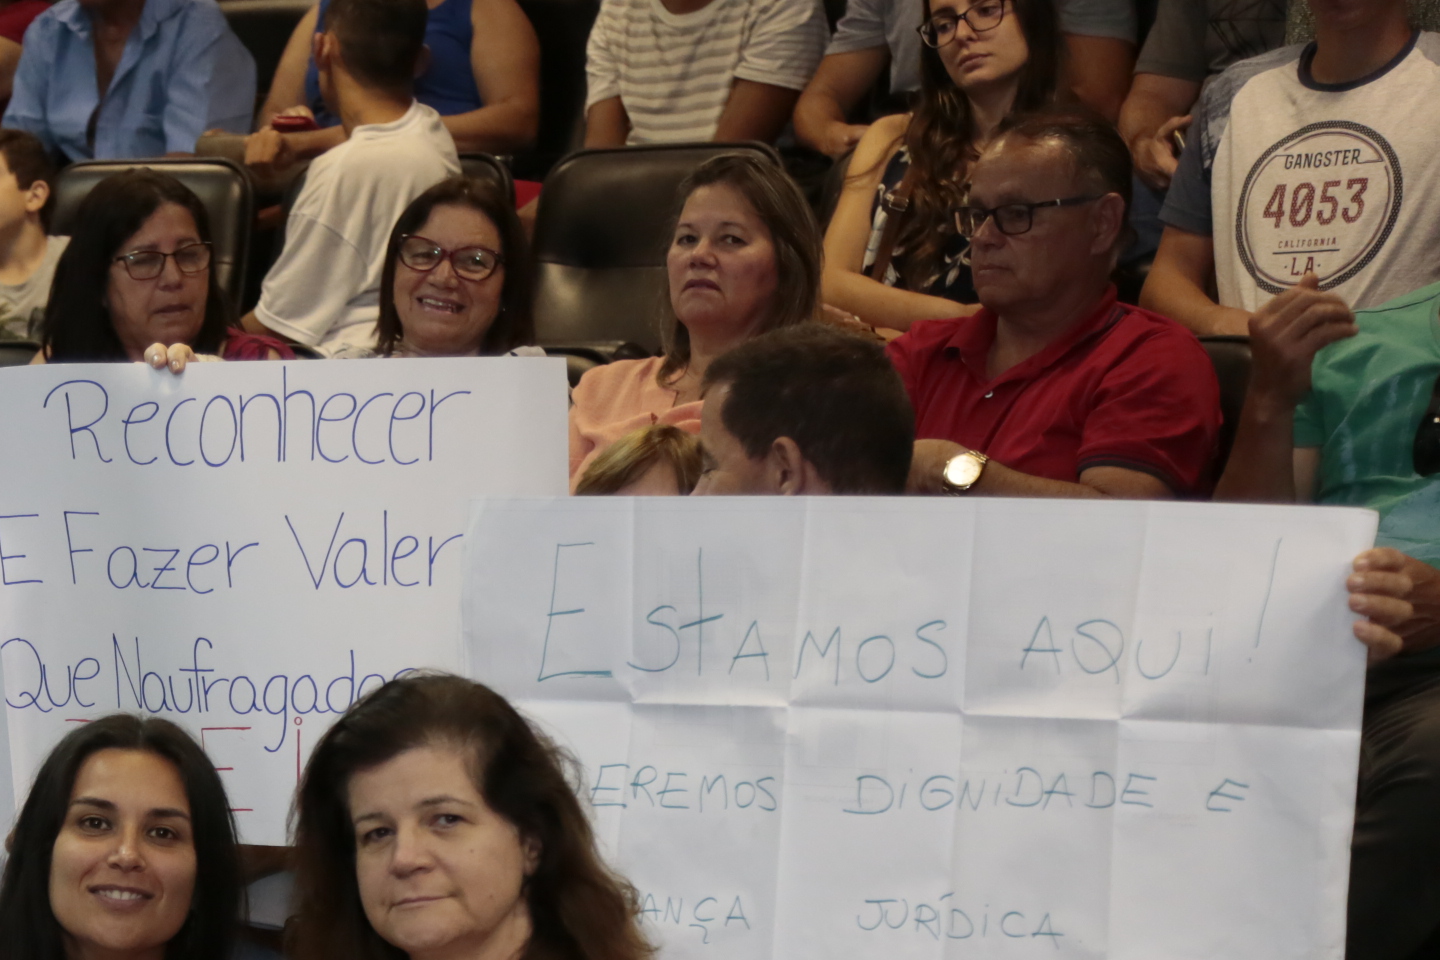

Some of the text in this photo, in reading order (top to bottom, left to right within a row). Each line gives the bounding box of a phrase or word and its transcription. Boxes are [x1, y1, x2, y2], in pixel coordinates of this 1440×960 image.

[1284, 148, 1361, 170] GANGSTER
[1262, 177, 1369, 229] 4053
[1277, 237, 1337, 249] CALIFORNIA
[43, 365, 473, 469] Reconhecer
[62, 510, 261, 595] Fazer
[283, 508, 465, 591] Valer
[0, 631, 420, 753] Que Naufragado
[588, 763, 778, 813] EREMOS
[1204, 777, 1251, 814] E
